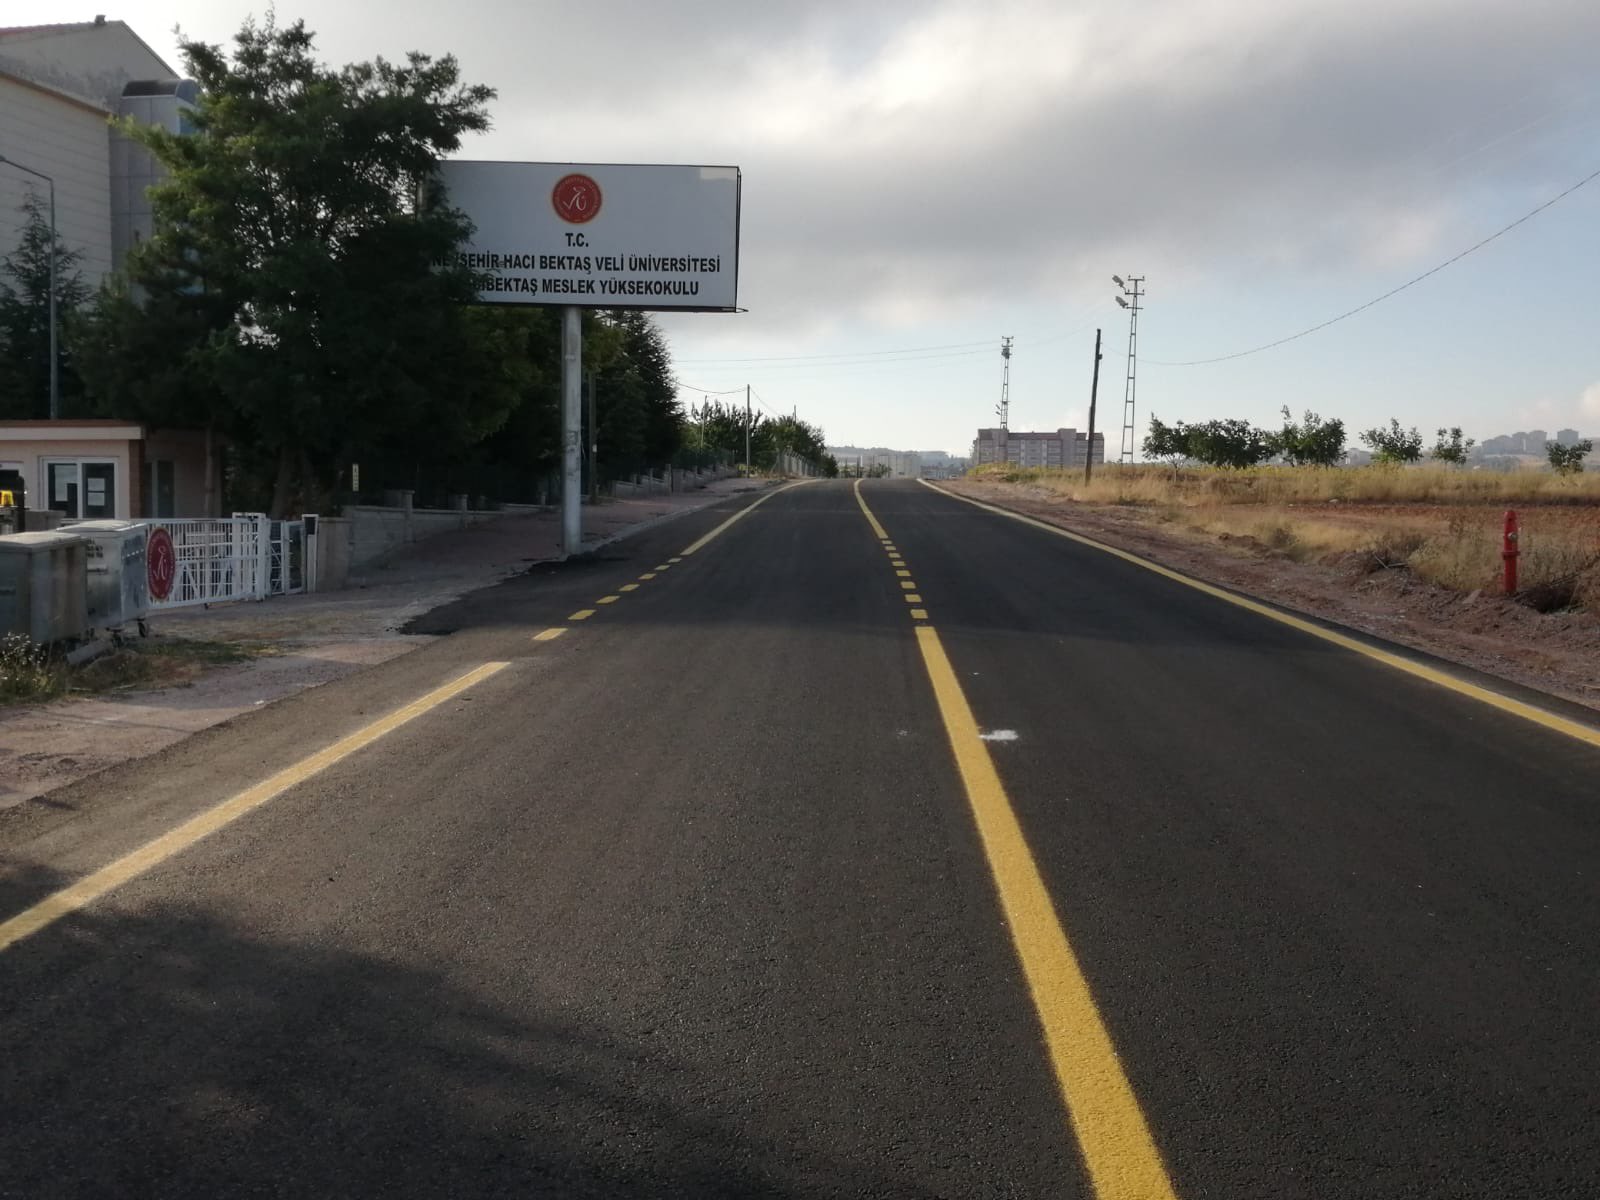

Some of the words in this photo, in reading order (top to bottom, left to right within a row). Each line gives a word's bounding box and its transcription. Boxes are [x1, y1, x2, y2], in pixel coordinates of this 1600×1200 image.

[565, 231, 589, 247] T.C.
[503, 254, 535, 270] HACI
[540, 255, 591, 275] BEKTAŞ
[595, 253, 624, 271] VELİ
[629, 254, 721, 273] ÜNİVERSİTESİ
[542, 279, 595, 295] MESLEK
[600, 277, 699, 296] YÜKSEKOKULU
